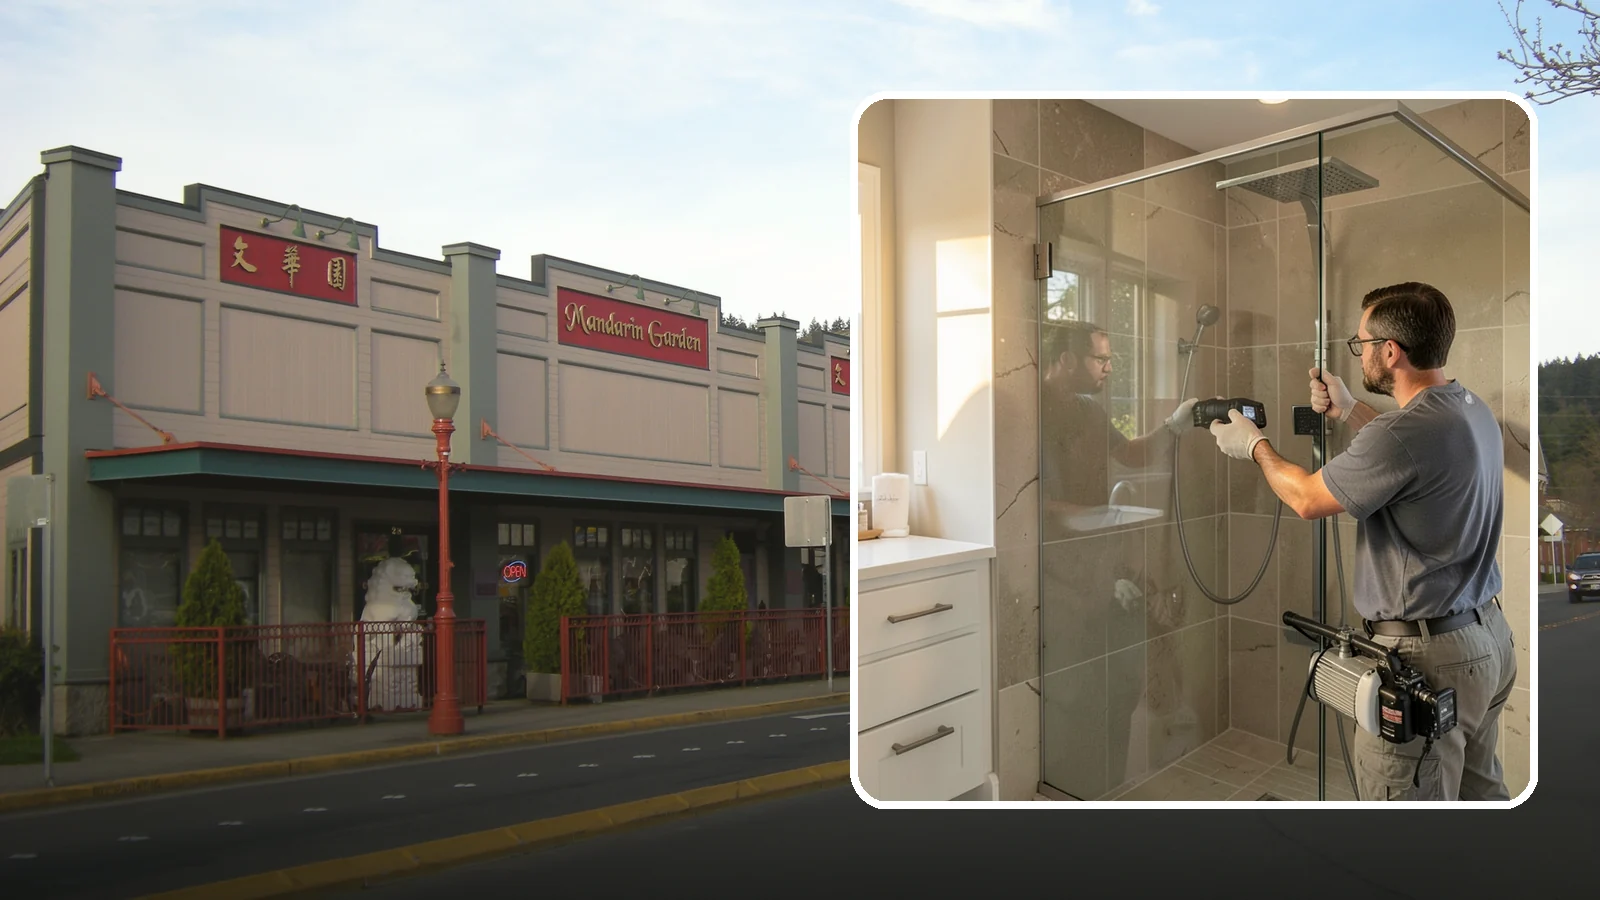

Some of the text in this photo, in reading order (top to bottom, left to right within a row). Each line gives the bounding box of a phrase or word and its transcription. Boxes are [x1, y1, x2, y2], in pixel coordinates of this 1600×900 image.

[564, 302, 701, 352] Mandarin Garden
[503, 565, 527, 577] OPEN
